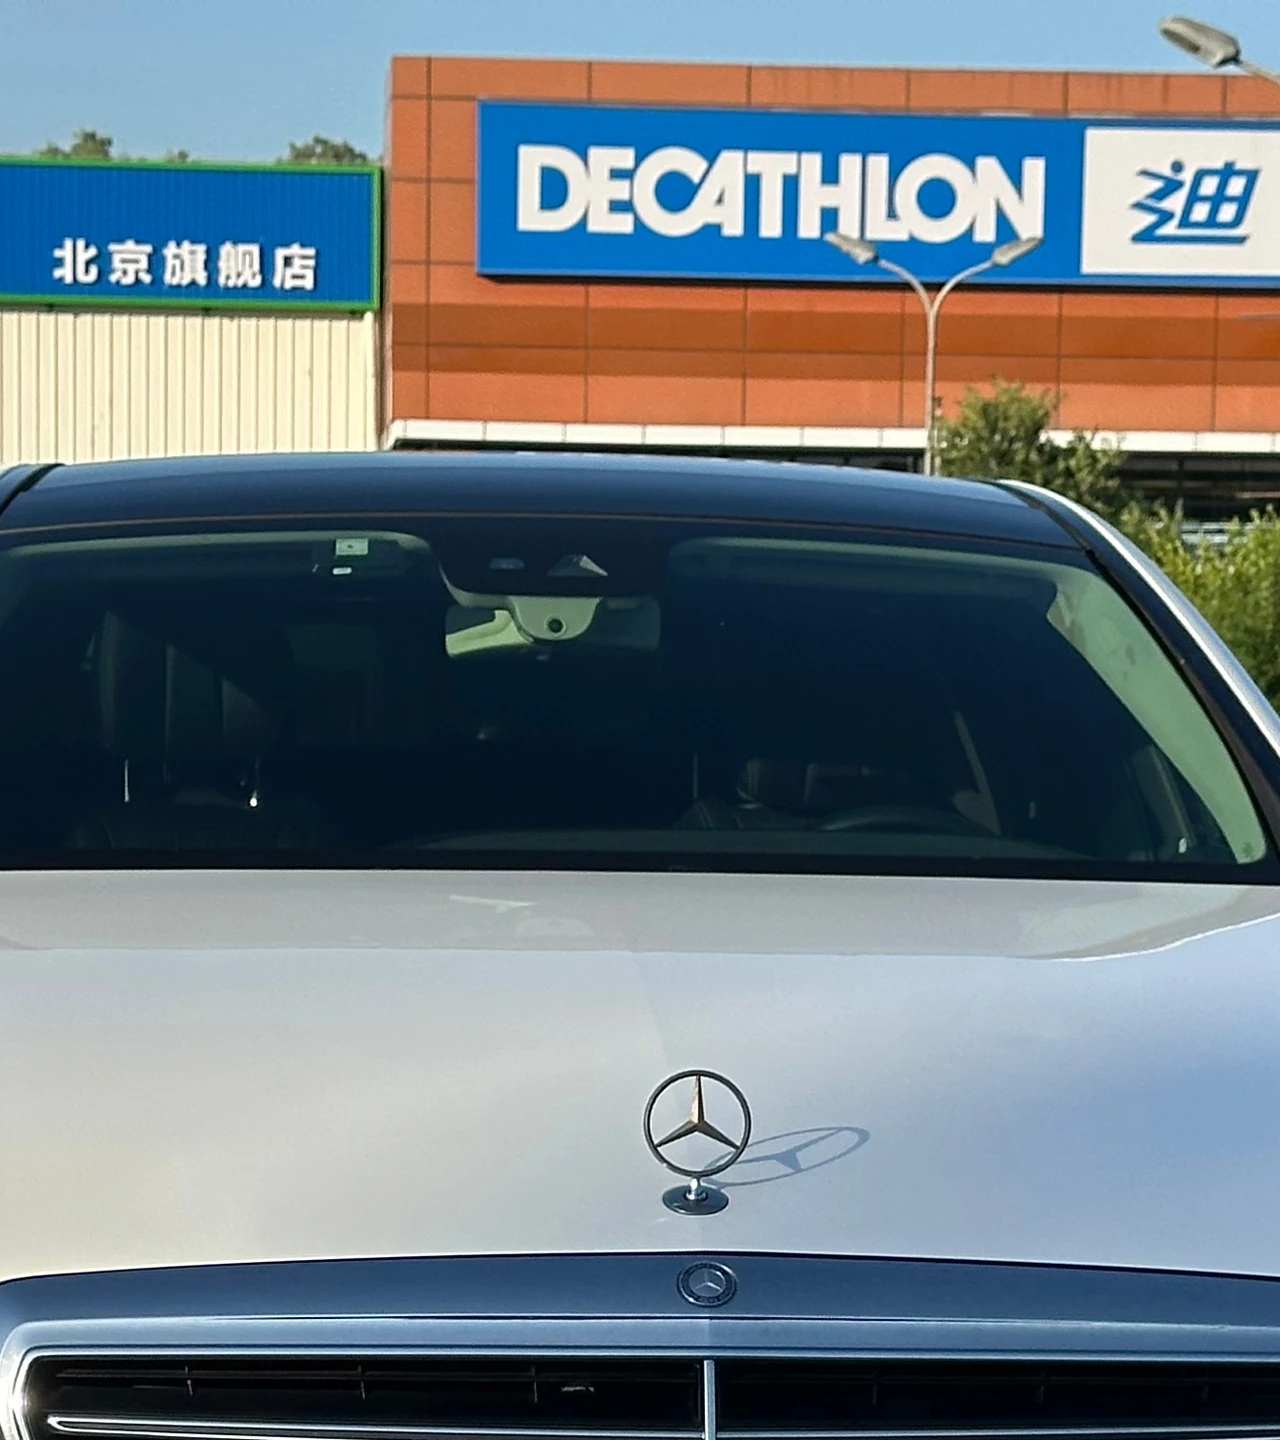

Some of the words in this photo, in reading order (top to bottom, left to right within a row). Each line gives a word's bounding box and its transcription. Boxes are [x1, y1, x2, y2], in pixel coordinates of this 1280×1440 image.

[517, 144, 1046, 244] DECATHLON
[52, 237, 317, 291] 北京旗舰店
